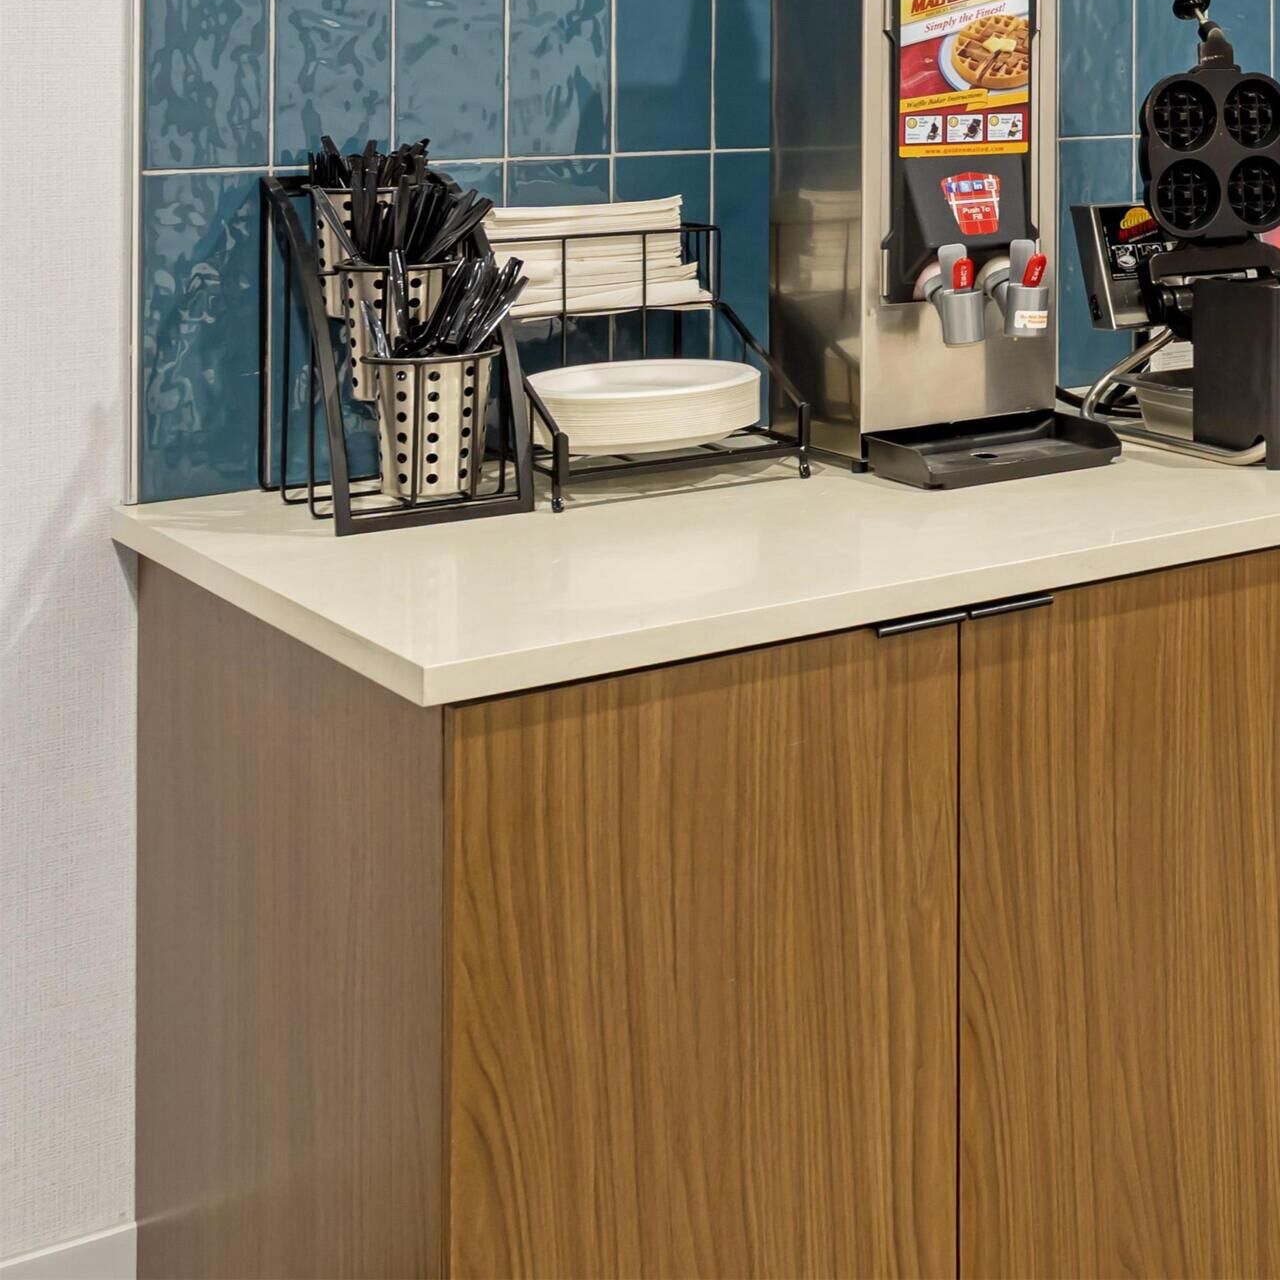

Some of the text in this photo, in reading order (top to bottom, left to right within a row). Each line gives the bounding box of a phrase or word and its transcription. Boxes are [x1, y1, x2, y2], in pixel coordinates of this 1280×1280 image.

[923, 16, 957, 33] Simply
[959, 12, 974, 24] the
[975, 2, 1007, 19] Finest!
[962, 205, 991, 214] Push To
